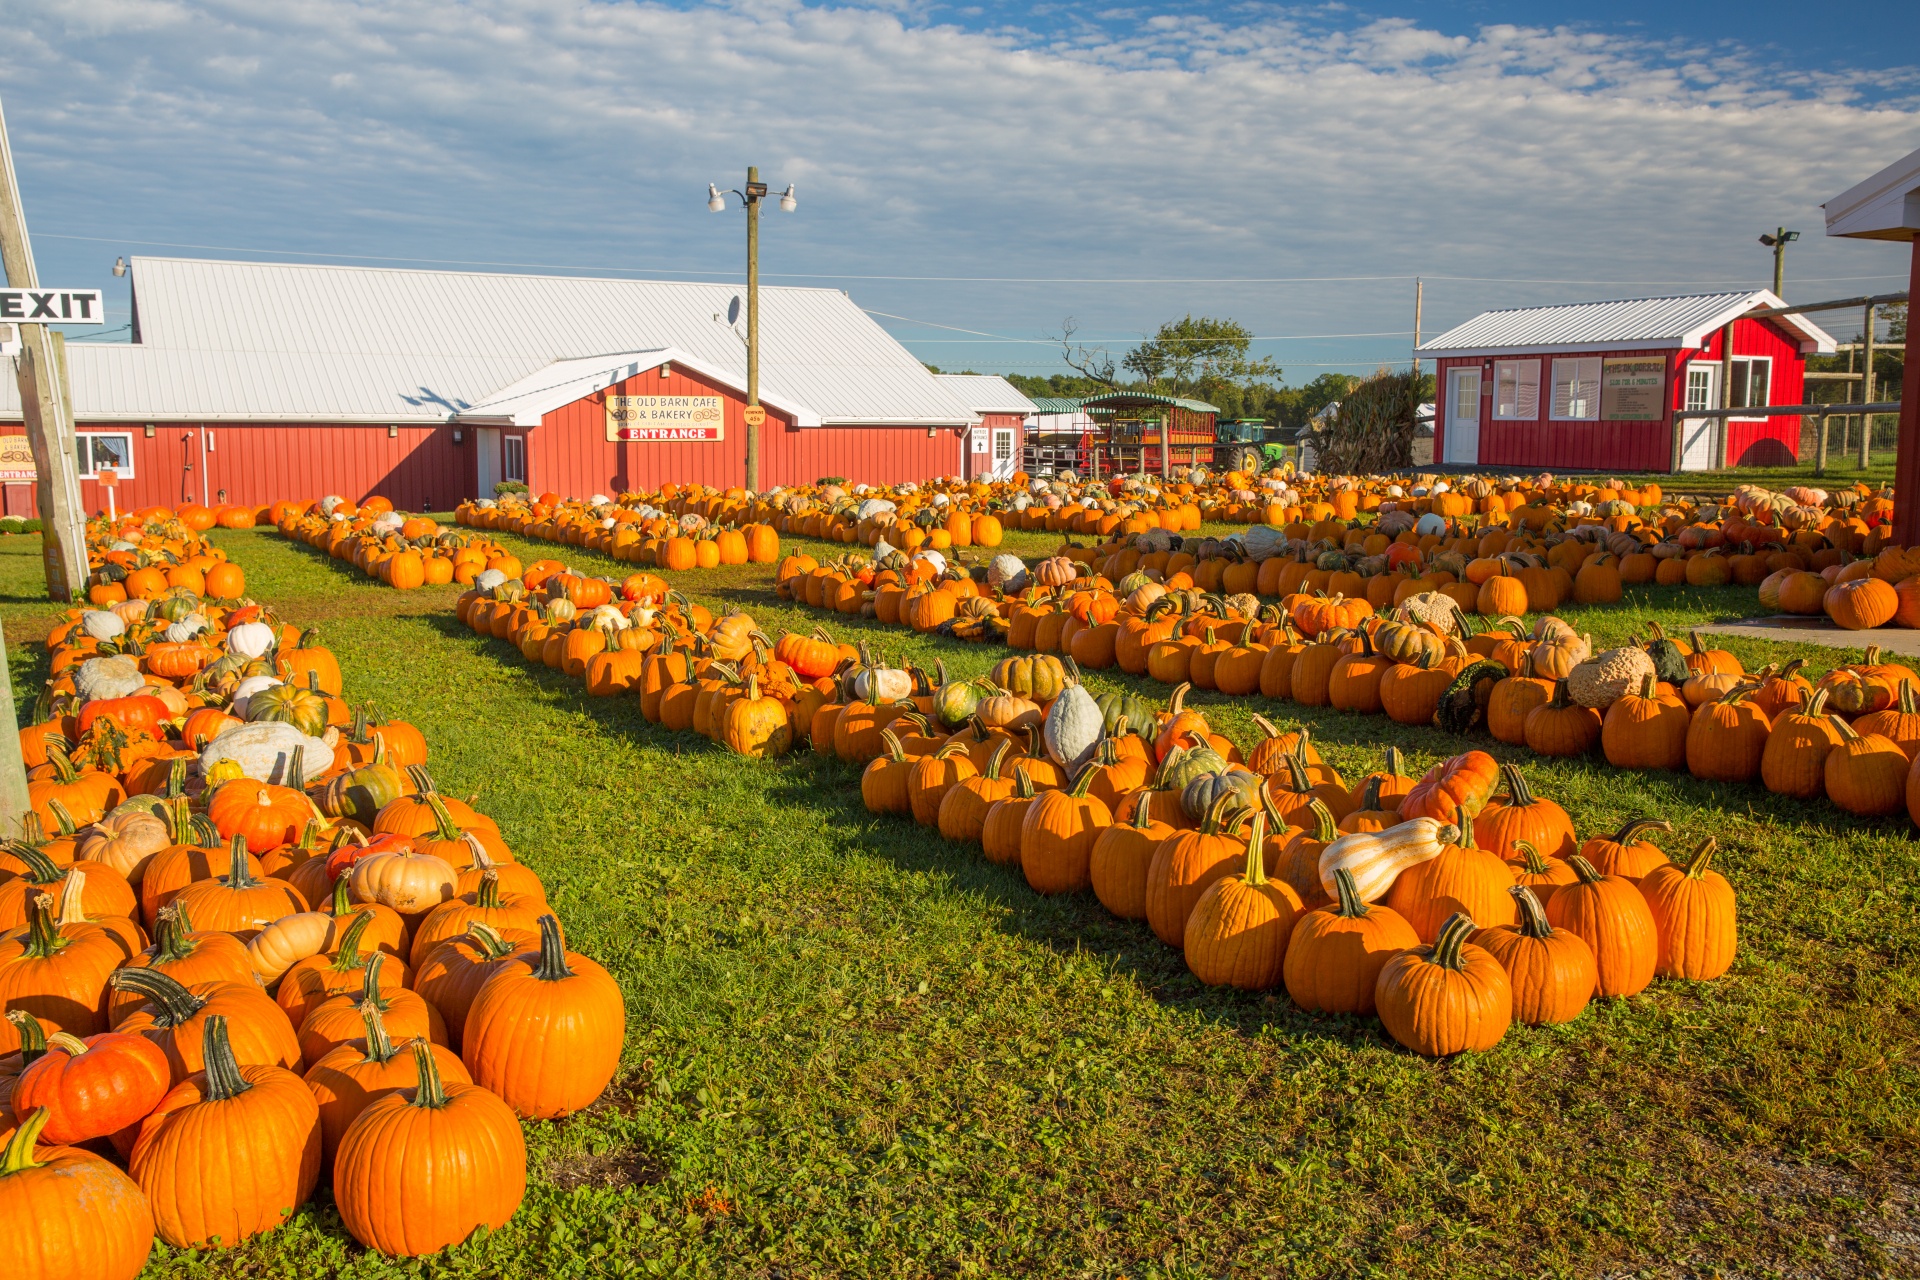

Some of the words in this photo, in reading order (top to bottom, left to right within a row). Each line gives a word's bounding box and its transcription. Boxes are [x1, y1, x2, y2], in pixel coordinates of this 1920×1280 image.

[0, 293, 96, 318] EXIT
[614, 397, 632, 406] THE
[637, 398, 656, 407] OLD
[660, 398, 689, 407] BARN
[692, 398, 717, 407] CAFE
[639, 410, 647, 419] &
[651, 410, 693, 419] BAKERY
[630, 429, 706, 438] ENTRANCE
